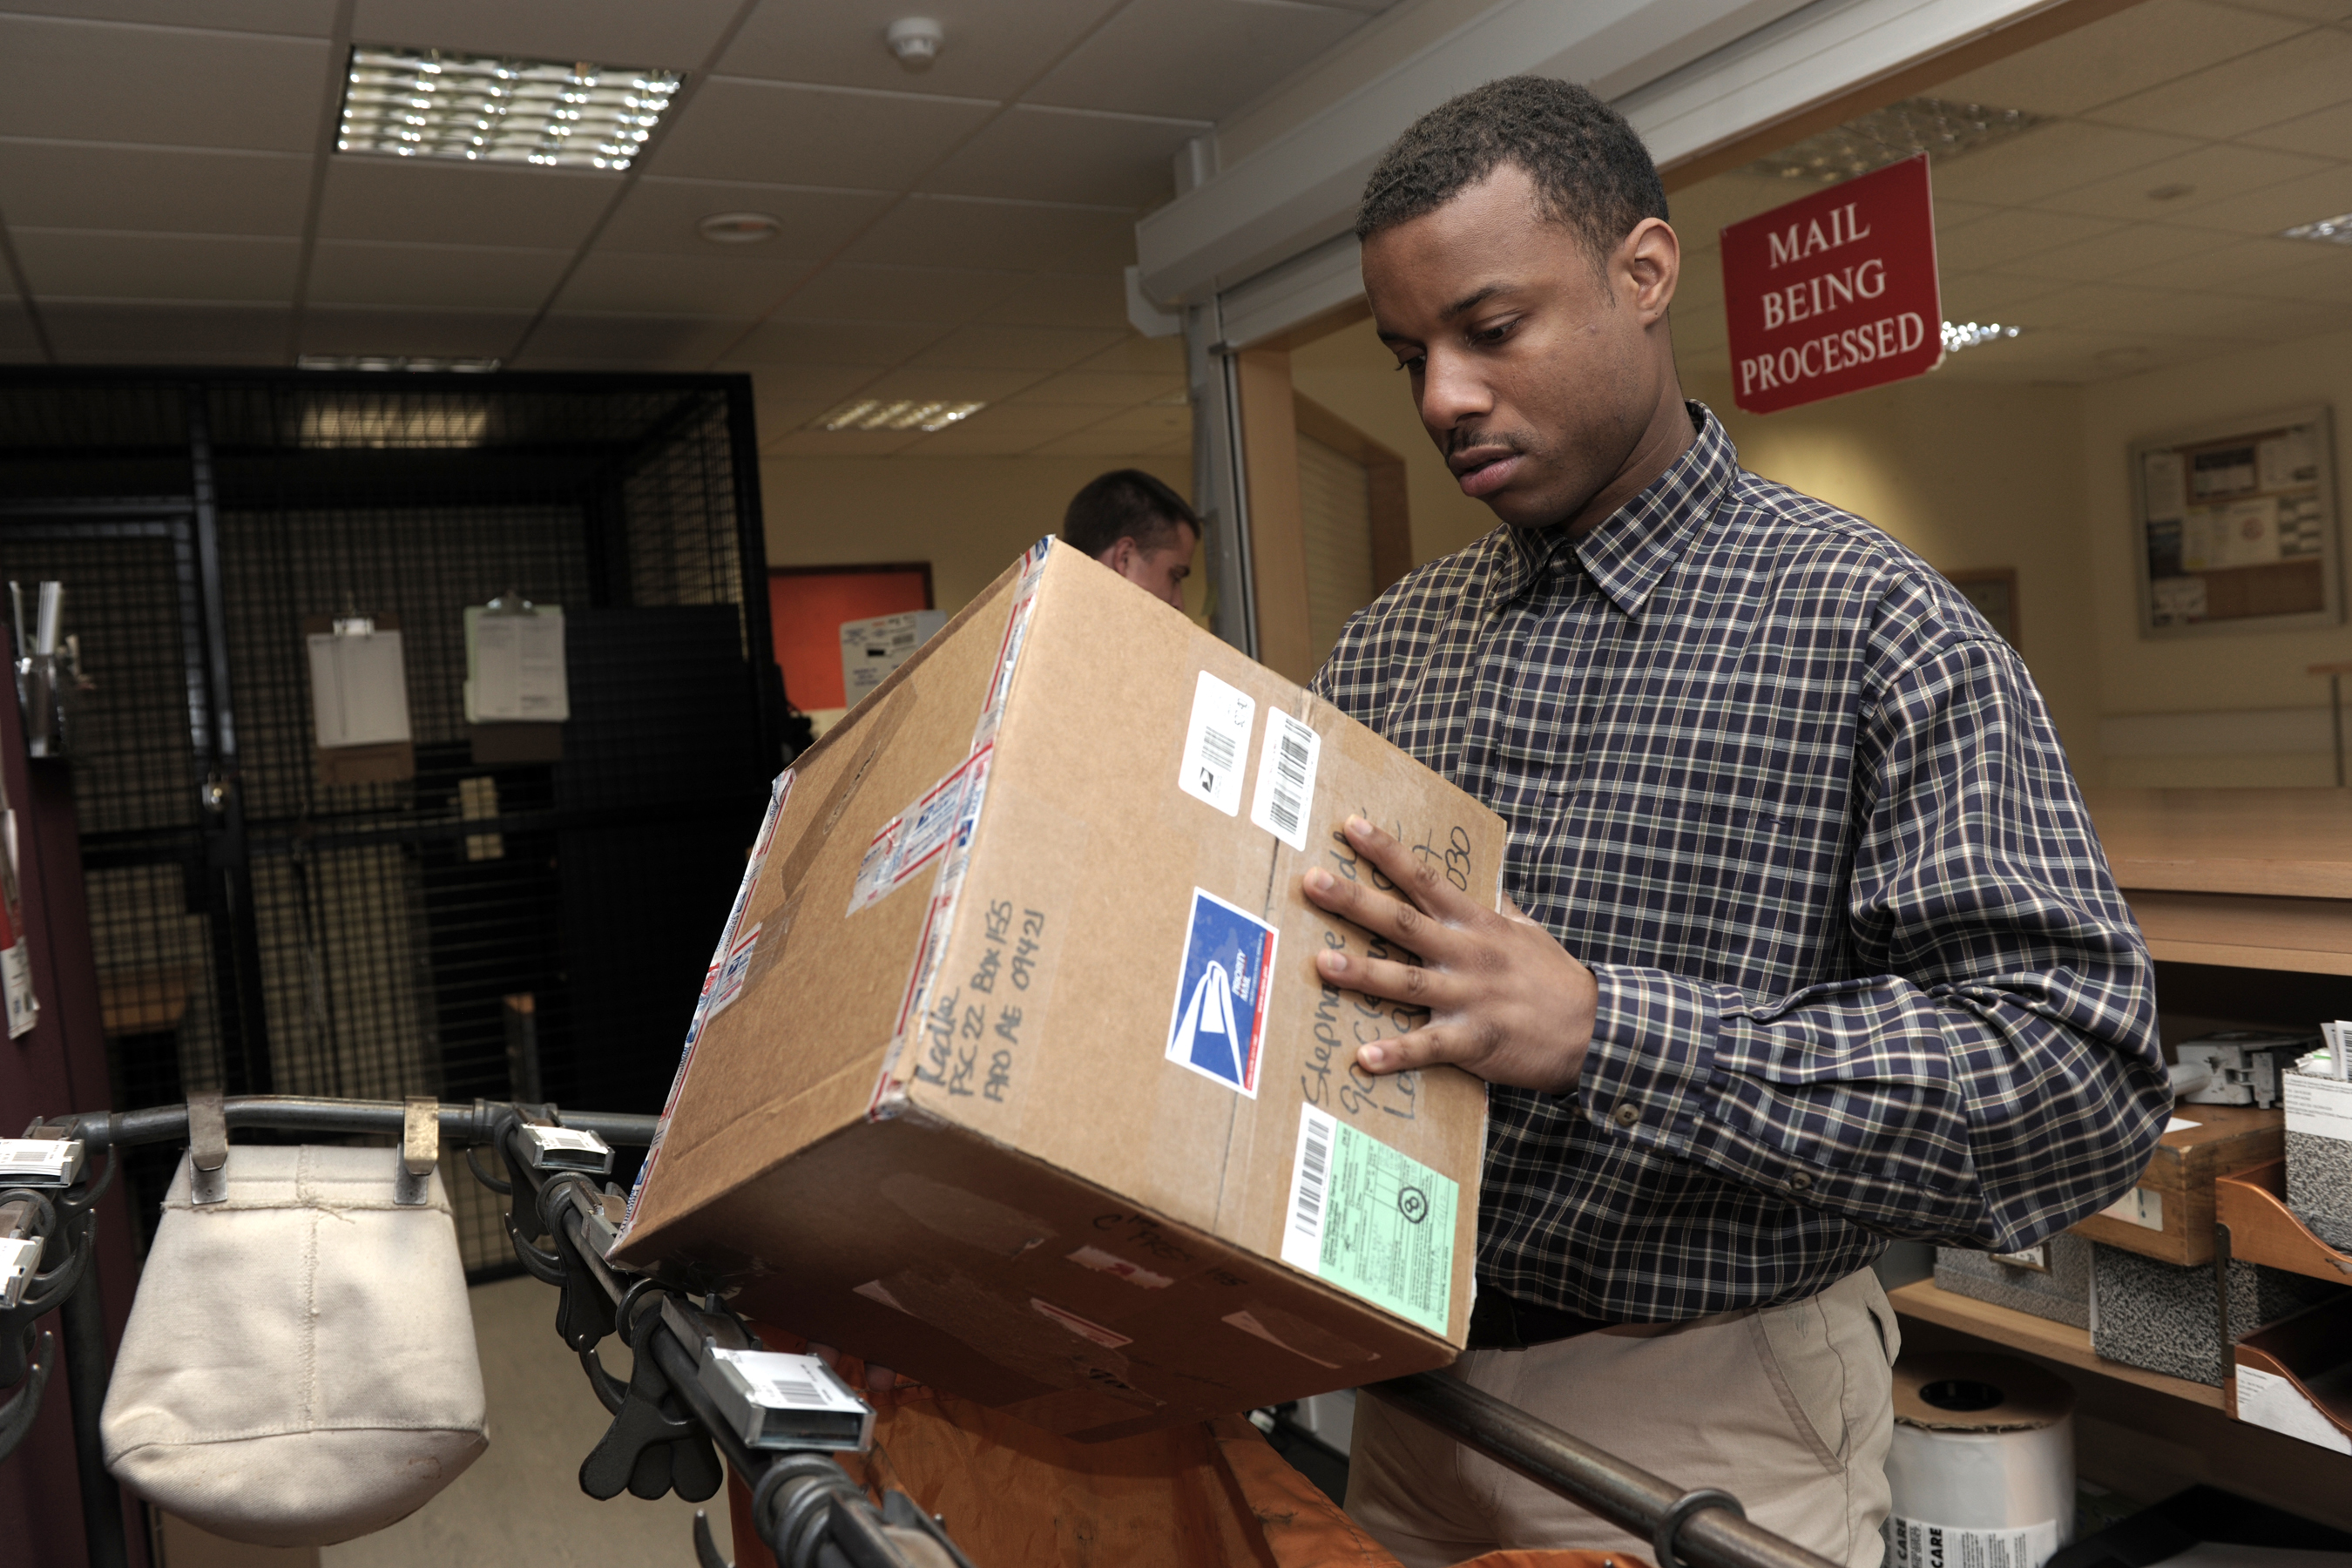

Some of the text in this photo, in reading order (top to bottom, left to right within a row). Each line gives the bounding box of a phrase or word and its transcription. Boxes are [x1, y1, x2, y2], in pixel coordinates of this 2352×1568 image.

[1767, 202, 1871, 269] MAIL
[1761, 259, 1887, 331] BEING
[1740, 312, 1925, 395] PROCESSED
[1232, 948, 1247, 996] PRIORITY
[963, 1004, 985, 1040] 22
[996, 1004, 1023, 1045] AE
[983, 1050, 1012, 1103] APO
[1896, 1518, 1908, 1561] CARE
[1930, 1528, 1943, 1568] CARE
